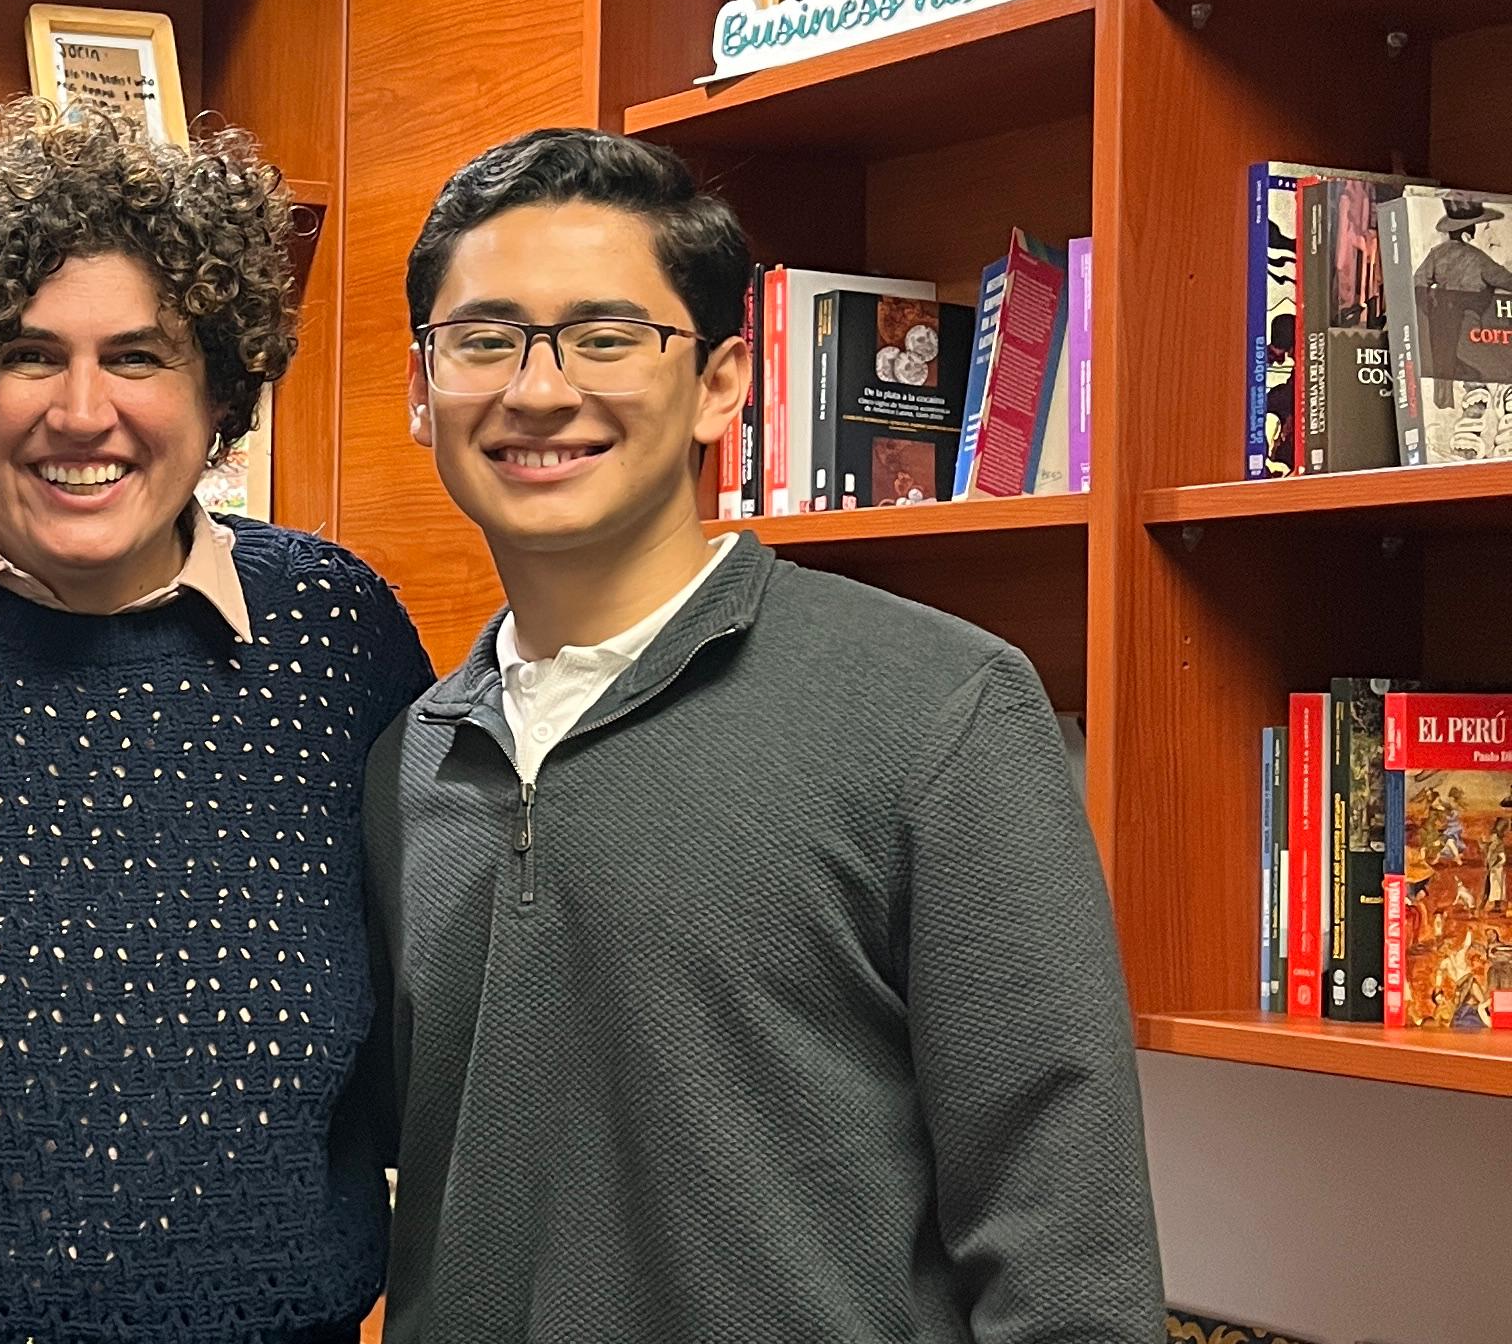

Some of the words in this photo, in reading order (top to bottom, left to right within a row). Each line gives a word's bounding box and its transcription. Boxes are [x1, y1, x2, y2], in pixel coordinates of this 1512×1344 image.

[1255, 336, 1265, 382] obrera
[1356, 348, 1389, 365] HIST
[1357, 367, 1395, 385] CON
[1309, 384, 1318, 435] HISTORIA
[1418, 716, 1444, 743] EL
[1447, 710, 1507, 744] PERÚ
